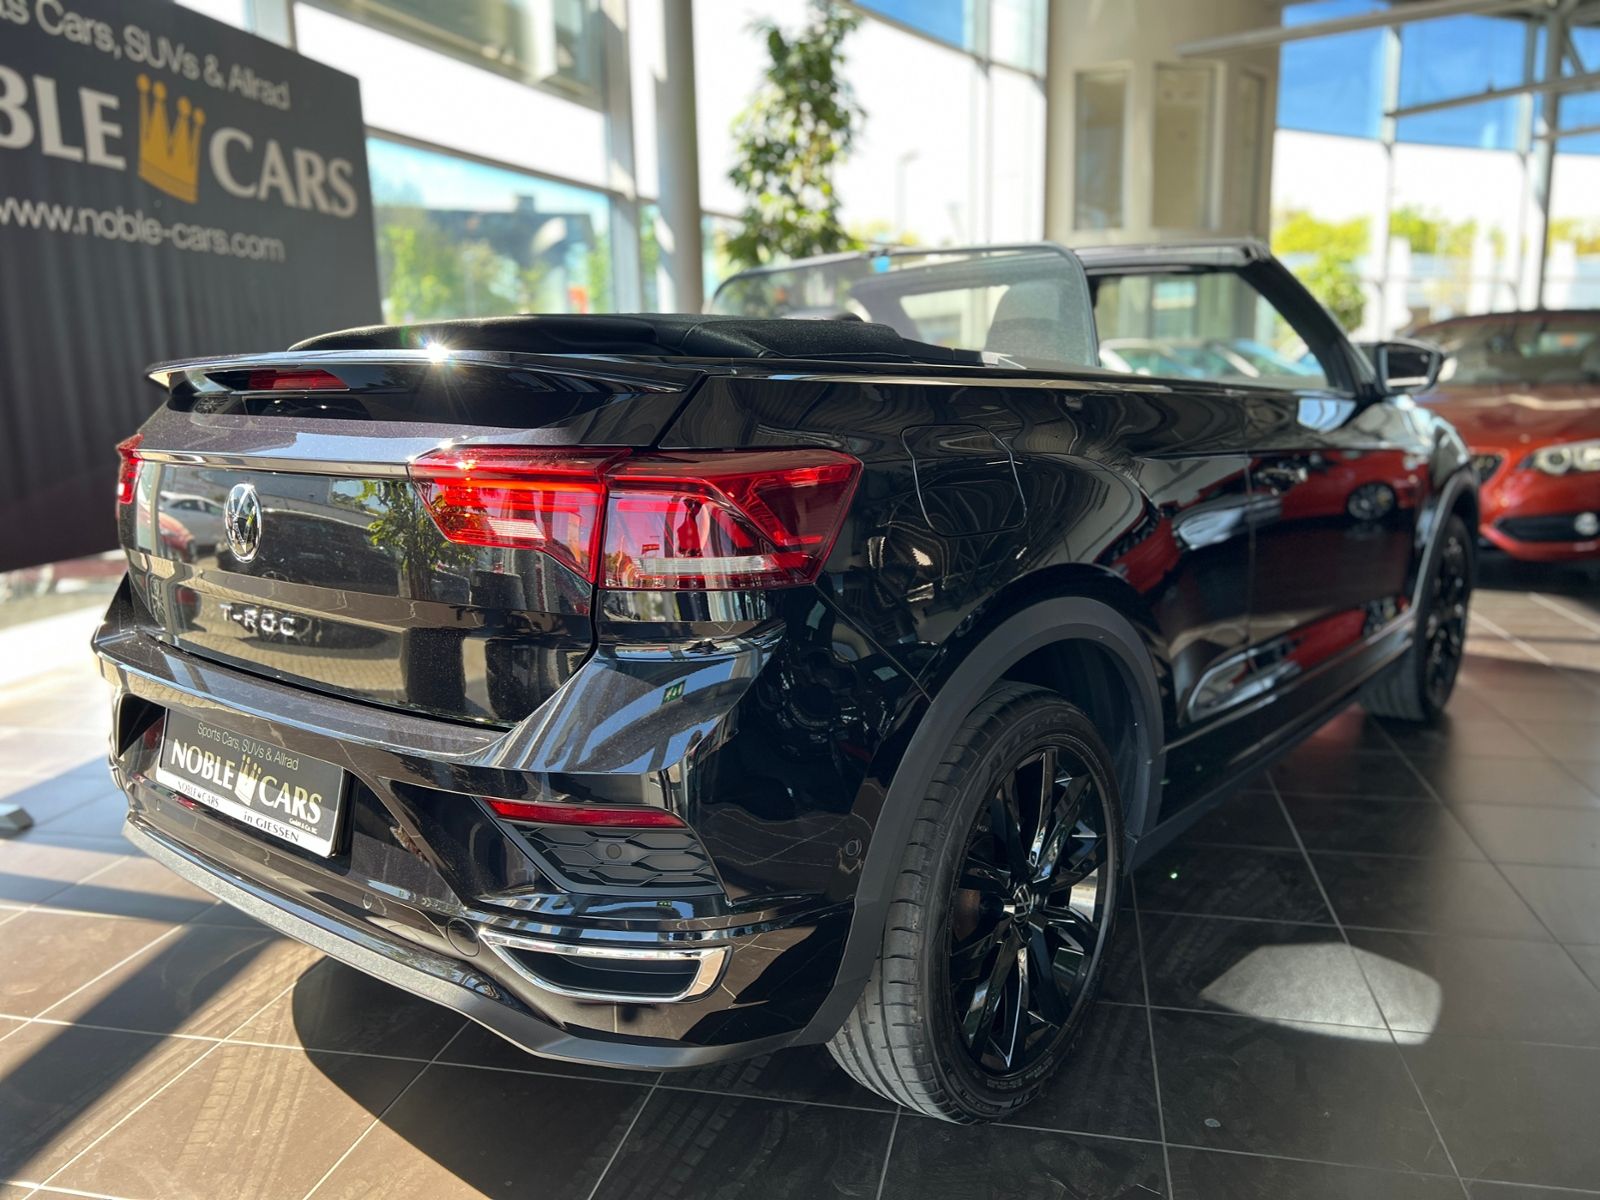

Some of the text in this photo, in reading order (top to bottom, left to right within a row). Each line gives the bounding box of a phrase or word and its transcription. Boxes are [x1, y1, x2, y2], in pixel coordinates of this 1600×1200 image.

[36, 0, 121, 59] Cars,
[124, 24, 199, 80] SUVs
[203, 54, 225, 88] &
[228, 64, 291, 111] Allrad
[219, 603, 296, 636] T-ROC
[197, 723, 299, 771] Sports Cars, SUVs & Allrad
[171, 739, 323, 824] NOBLE CARS
[244, 811, 253, 823] in
[256, 818, 299, 843] GIESSEN
